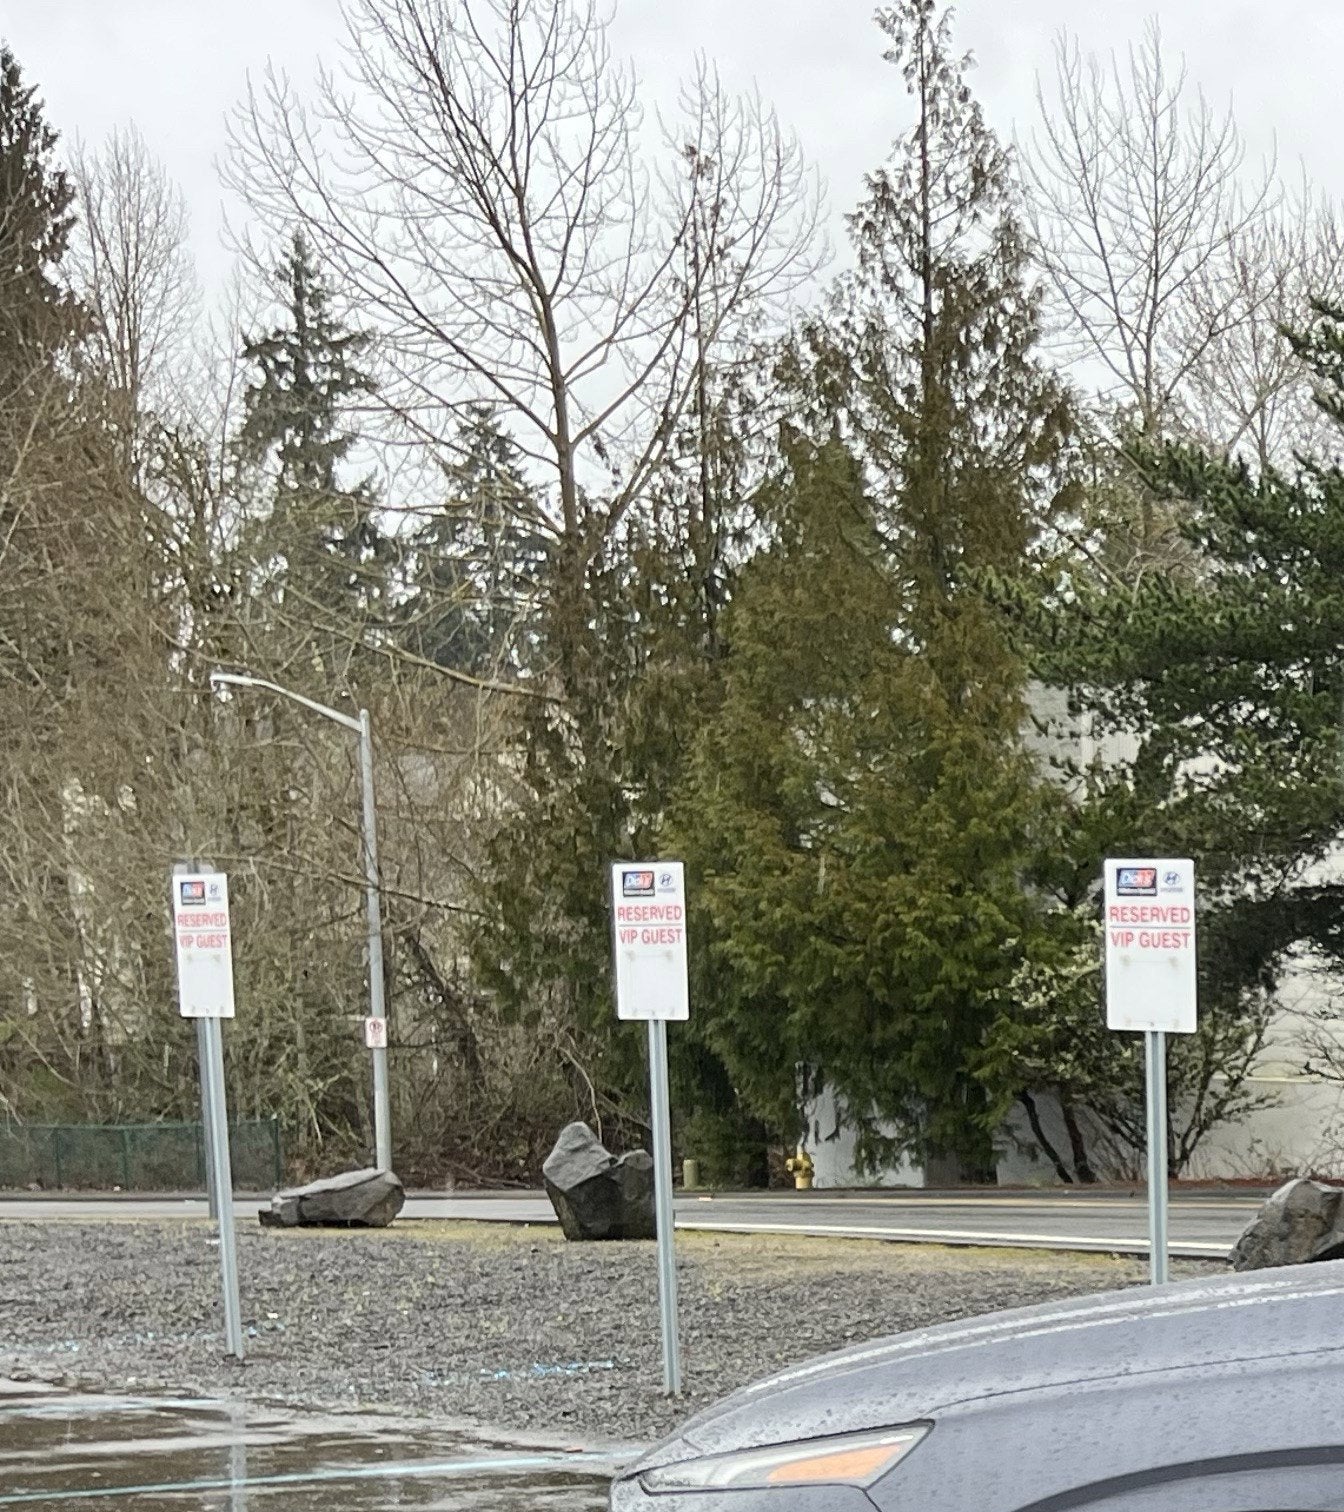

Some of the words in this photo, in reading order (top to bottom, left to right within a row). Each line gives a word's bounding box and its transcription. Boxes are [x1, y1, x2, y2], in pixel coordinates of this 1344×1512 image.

[177, 912, 227, 929] RESERVED
[617, 905, 682, 922] RESERVED
[1109, 906, 1191, 924] RESERVED
[179, 934, 194, 950] VIP
[196, 934, 228, 950] GUEST
[619, 928, 638, 945] VIP
[641, 928, 683, 945] GUEST
[1110, 931, 1134, 949] VIP
[1138, 931, 1191, 949] GUEST
